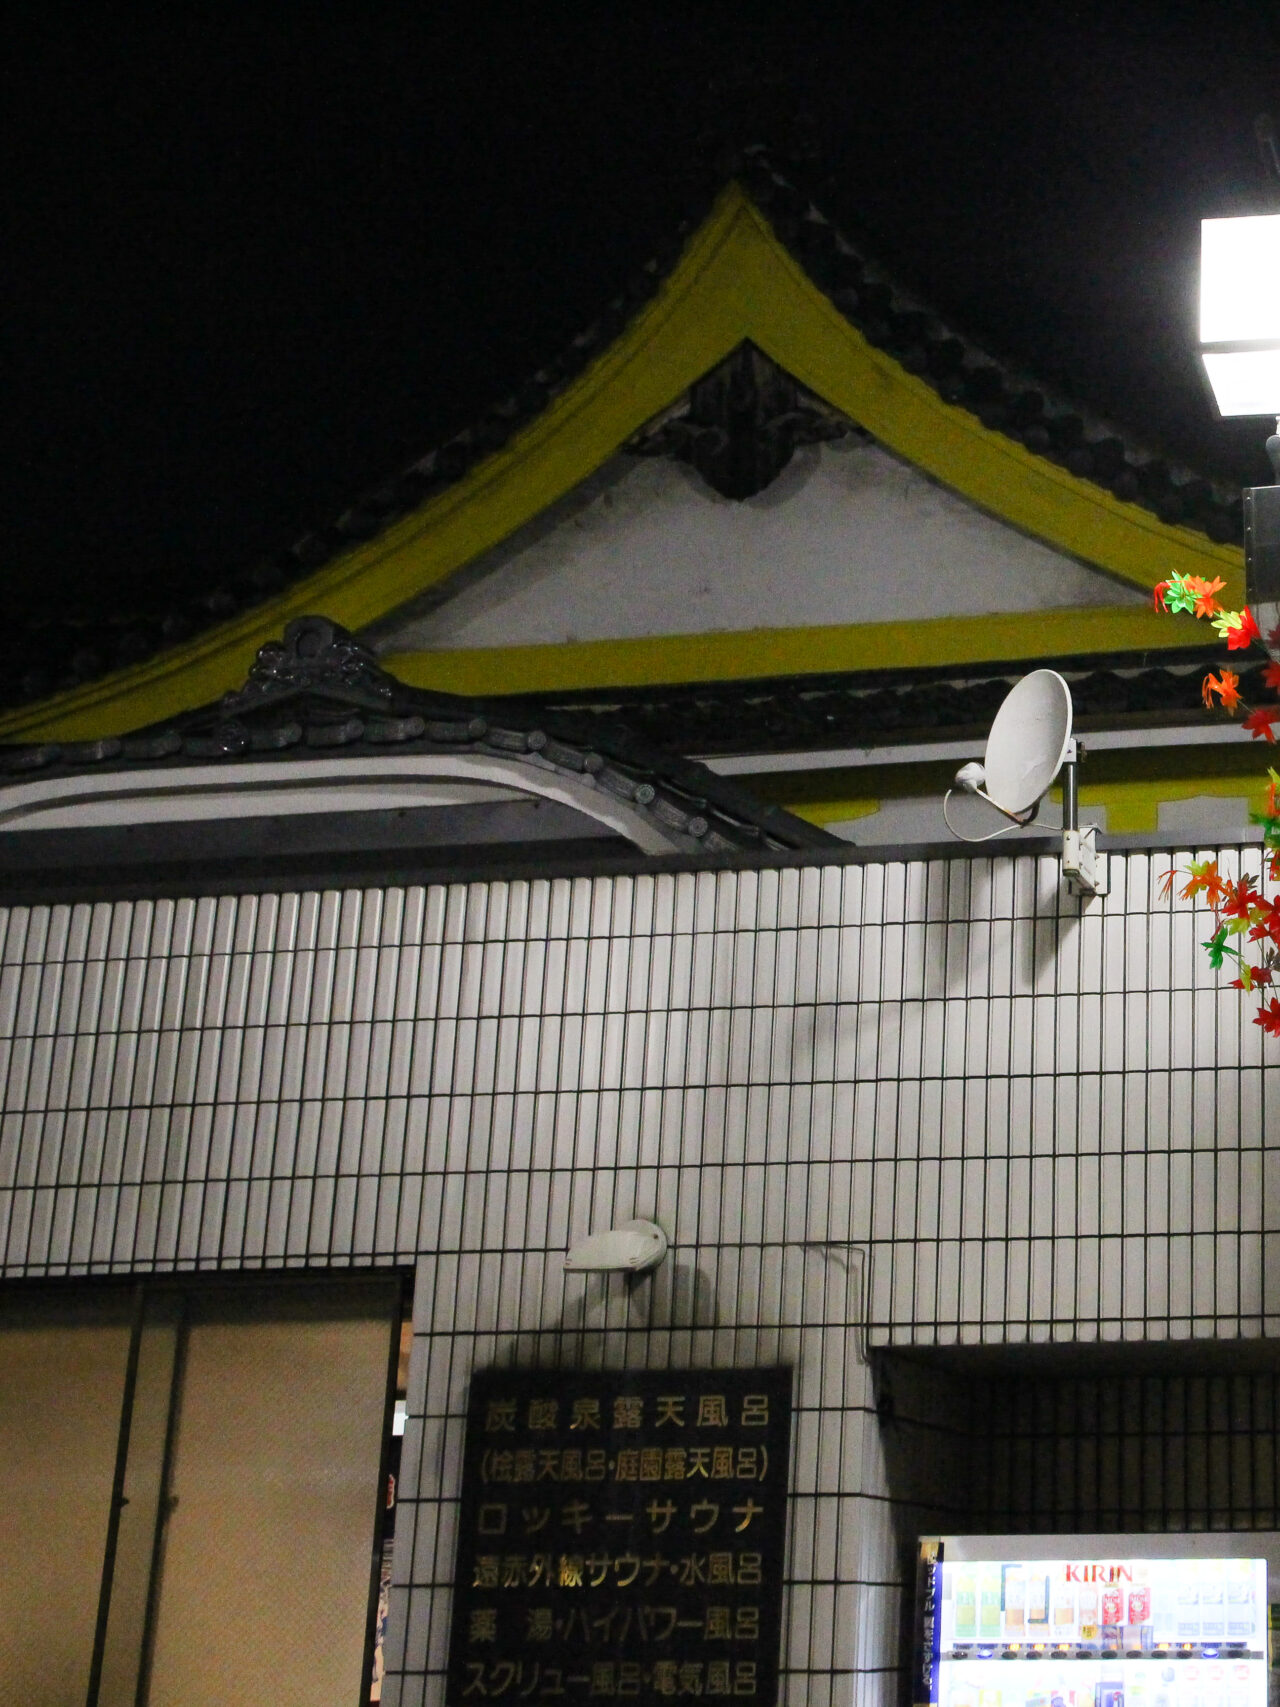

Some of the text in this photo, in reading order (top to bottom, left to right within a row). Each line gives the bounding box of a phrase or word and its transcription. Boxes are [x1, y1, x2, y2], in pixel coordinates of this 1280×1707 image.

[485, 1394, 770, 1433] 炭酸泉露天風呂
[477, 1497, 764, 1535] ロッキーサウナ
[472, 1550, 762, 1588] 遠赤外線サウナ・水風呂
[1066, 1564, 1133, 1583] KIRIN
